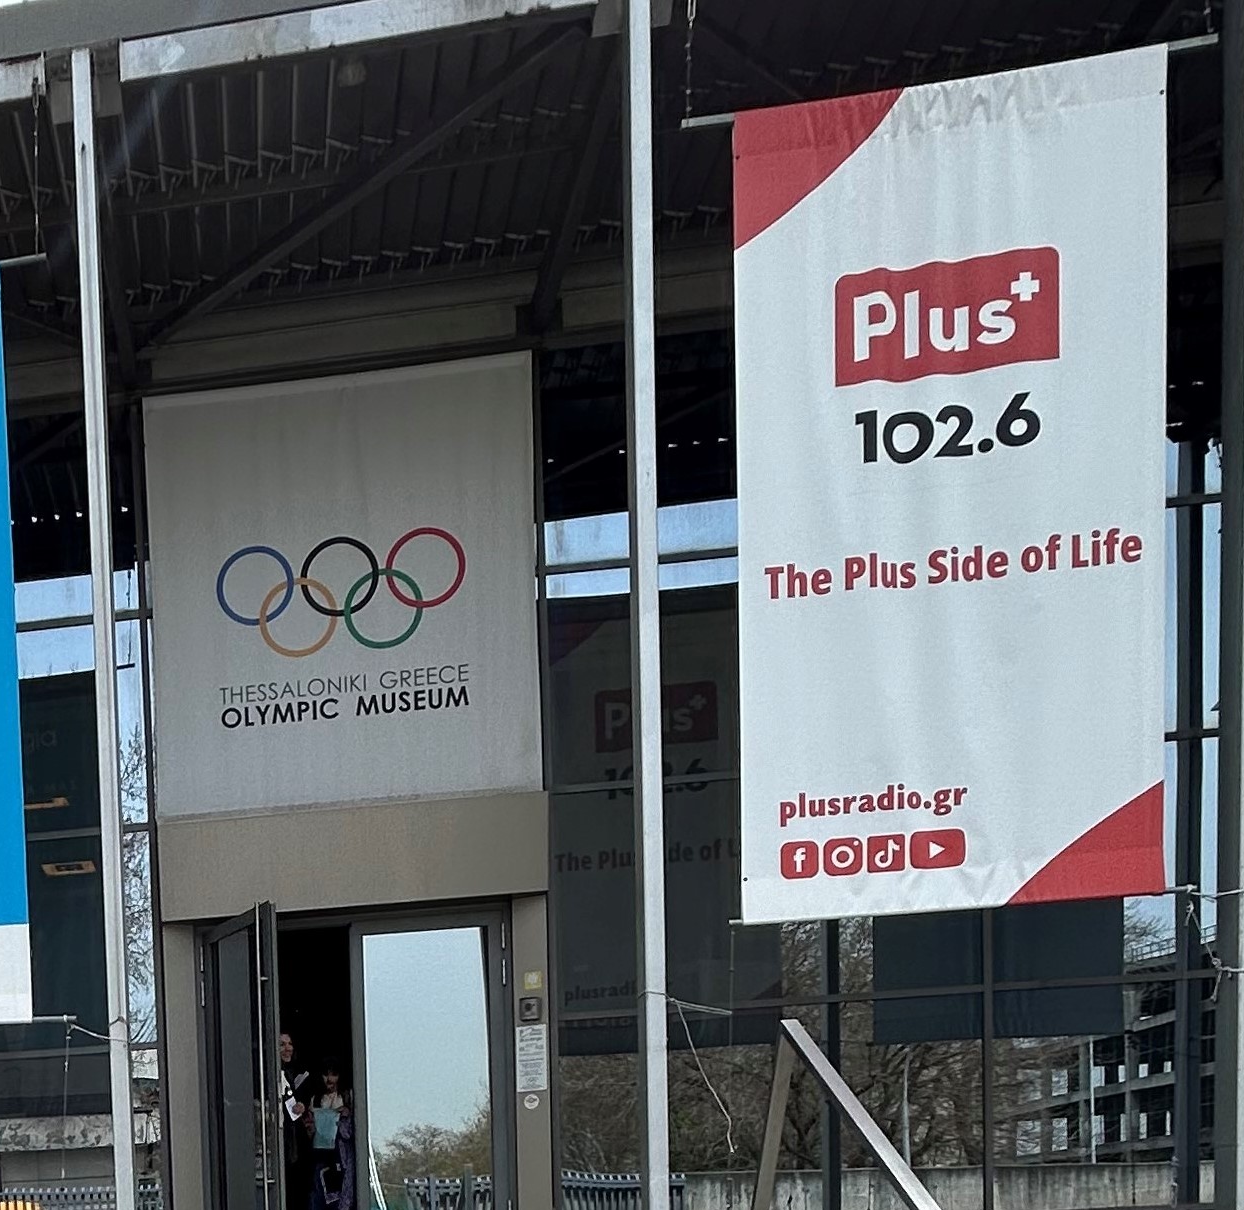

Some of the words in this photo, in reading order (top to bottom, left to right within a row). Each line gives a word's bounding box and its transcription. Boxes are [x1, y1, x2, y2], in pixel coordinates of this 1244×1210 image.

[855, 391, 1041, 465] 102.6
[765, 562, 832, 599] The
[844, 552, 916, 590] Plus
[928, 545, 1009, 584] Side
[1021, 533, 1062, 572] of
[1071, 527, 1143, 568] Life
[219, 673, 367, 704] THESSALONIKI
[379, 663, 469, 689] GREECE
[221, 698, 339, 728] OLYMPIC
[356, 686, 469, 716] MUSEUM
[780, 783, 968, 827] plusradio.gr
[599, 848, 635, 869] Plu
